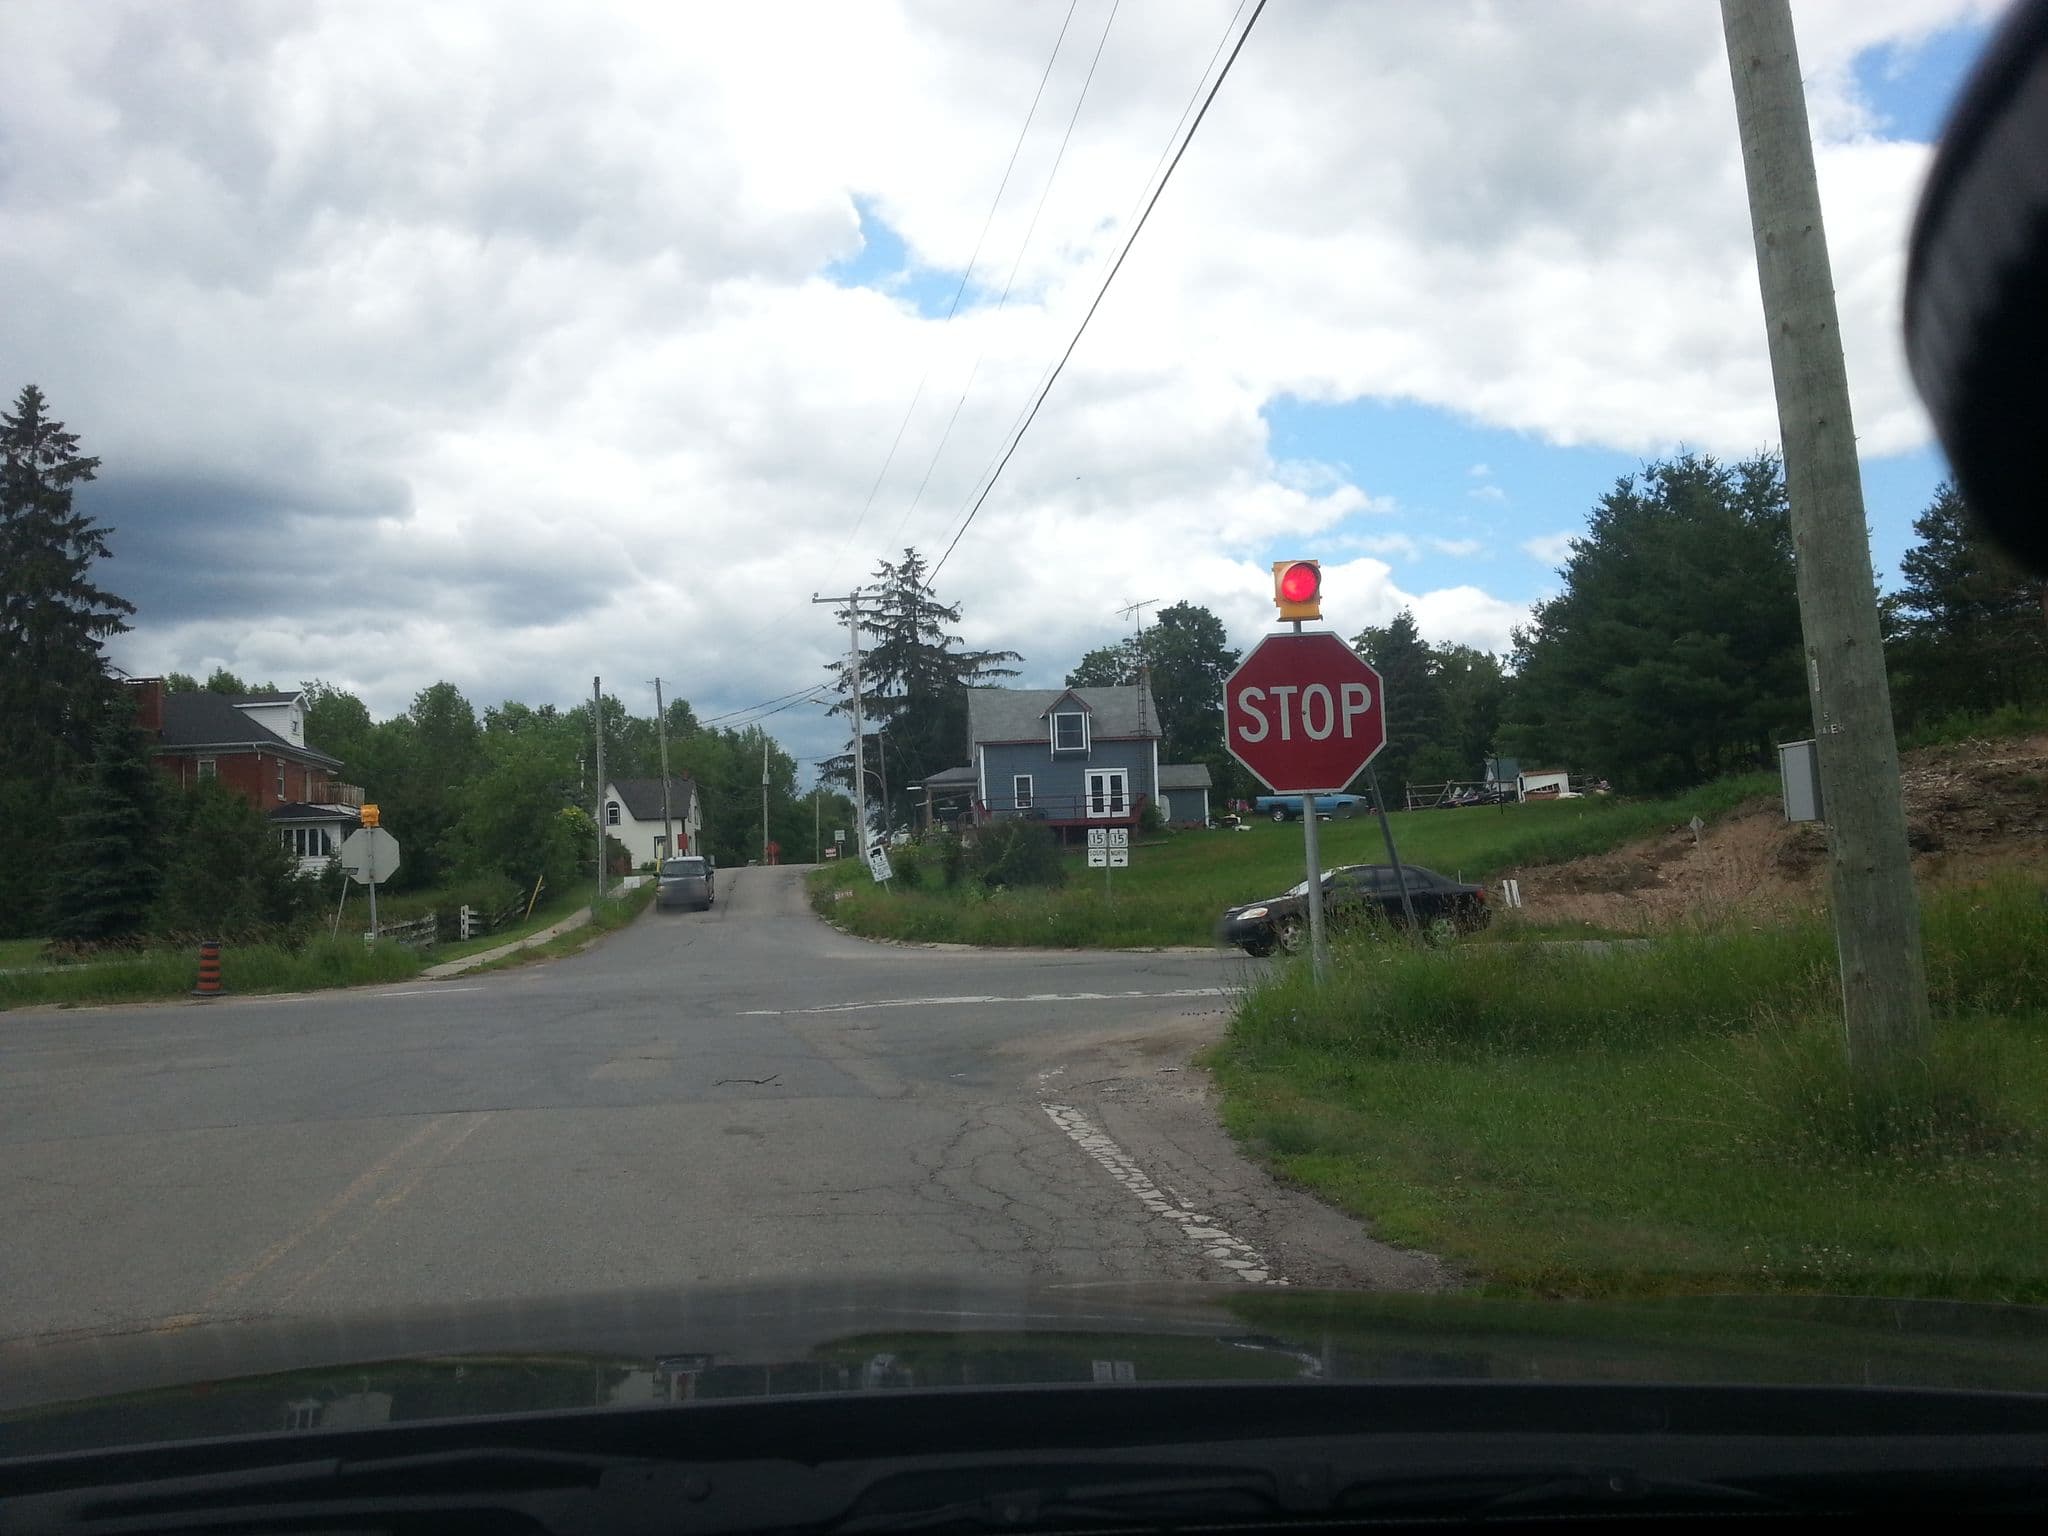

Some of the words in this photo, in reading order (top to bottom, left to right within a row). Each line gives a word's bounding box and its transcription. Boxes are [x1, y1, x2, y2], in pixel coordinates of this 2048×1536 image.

[1238, 683, 1371, 743] STOP
[1093, 834, 1103, 844] 15
[1114, 834, 1124, 844] 15
